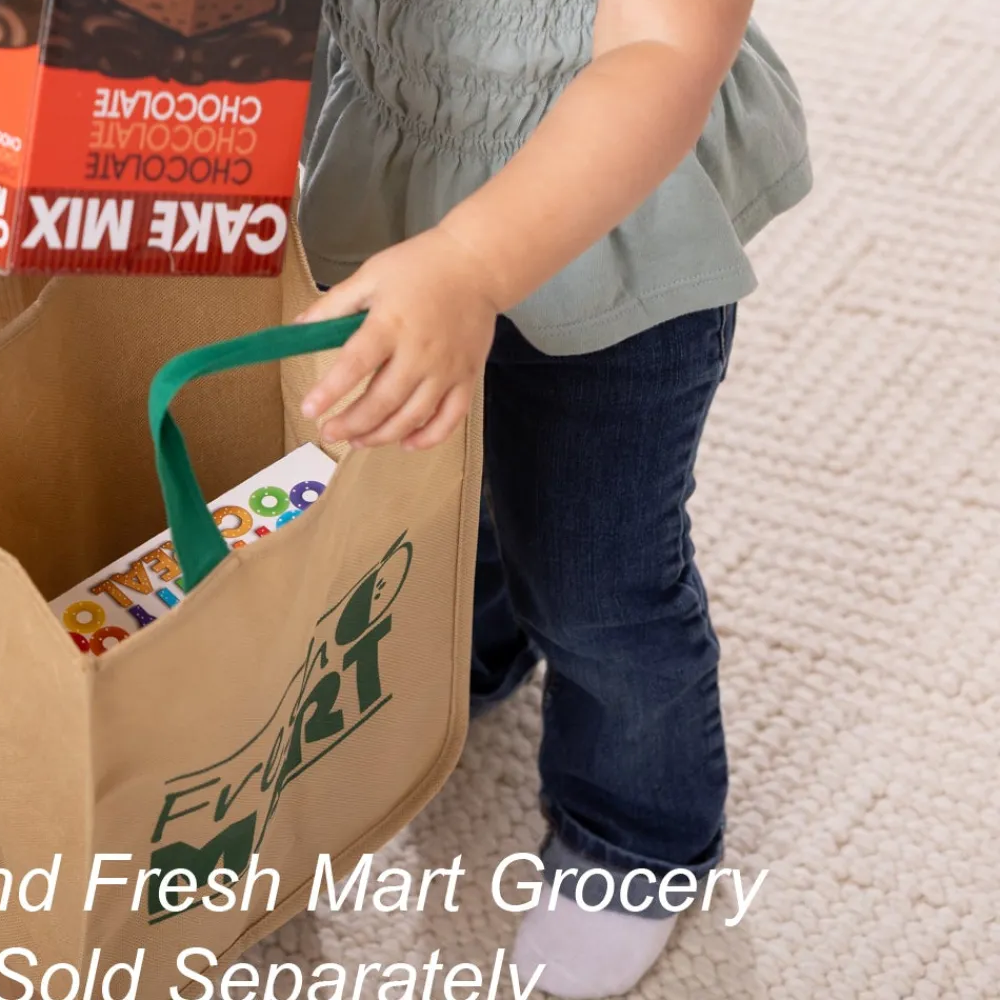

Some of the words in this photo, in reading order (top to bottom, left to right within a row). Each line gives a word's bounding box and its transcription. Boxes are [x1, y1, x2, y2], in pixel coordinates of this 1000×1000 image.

[93, 87, 262, 125] CHOCOLATE
[89, 120, 258, 155] CHOCOLATE
[85, 152, 253, 186] CHOCOLATE
[21, 195, 135, 251] MIX
[147, 200, 287, 255] CAKE
